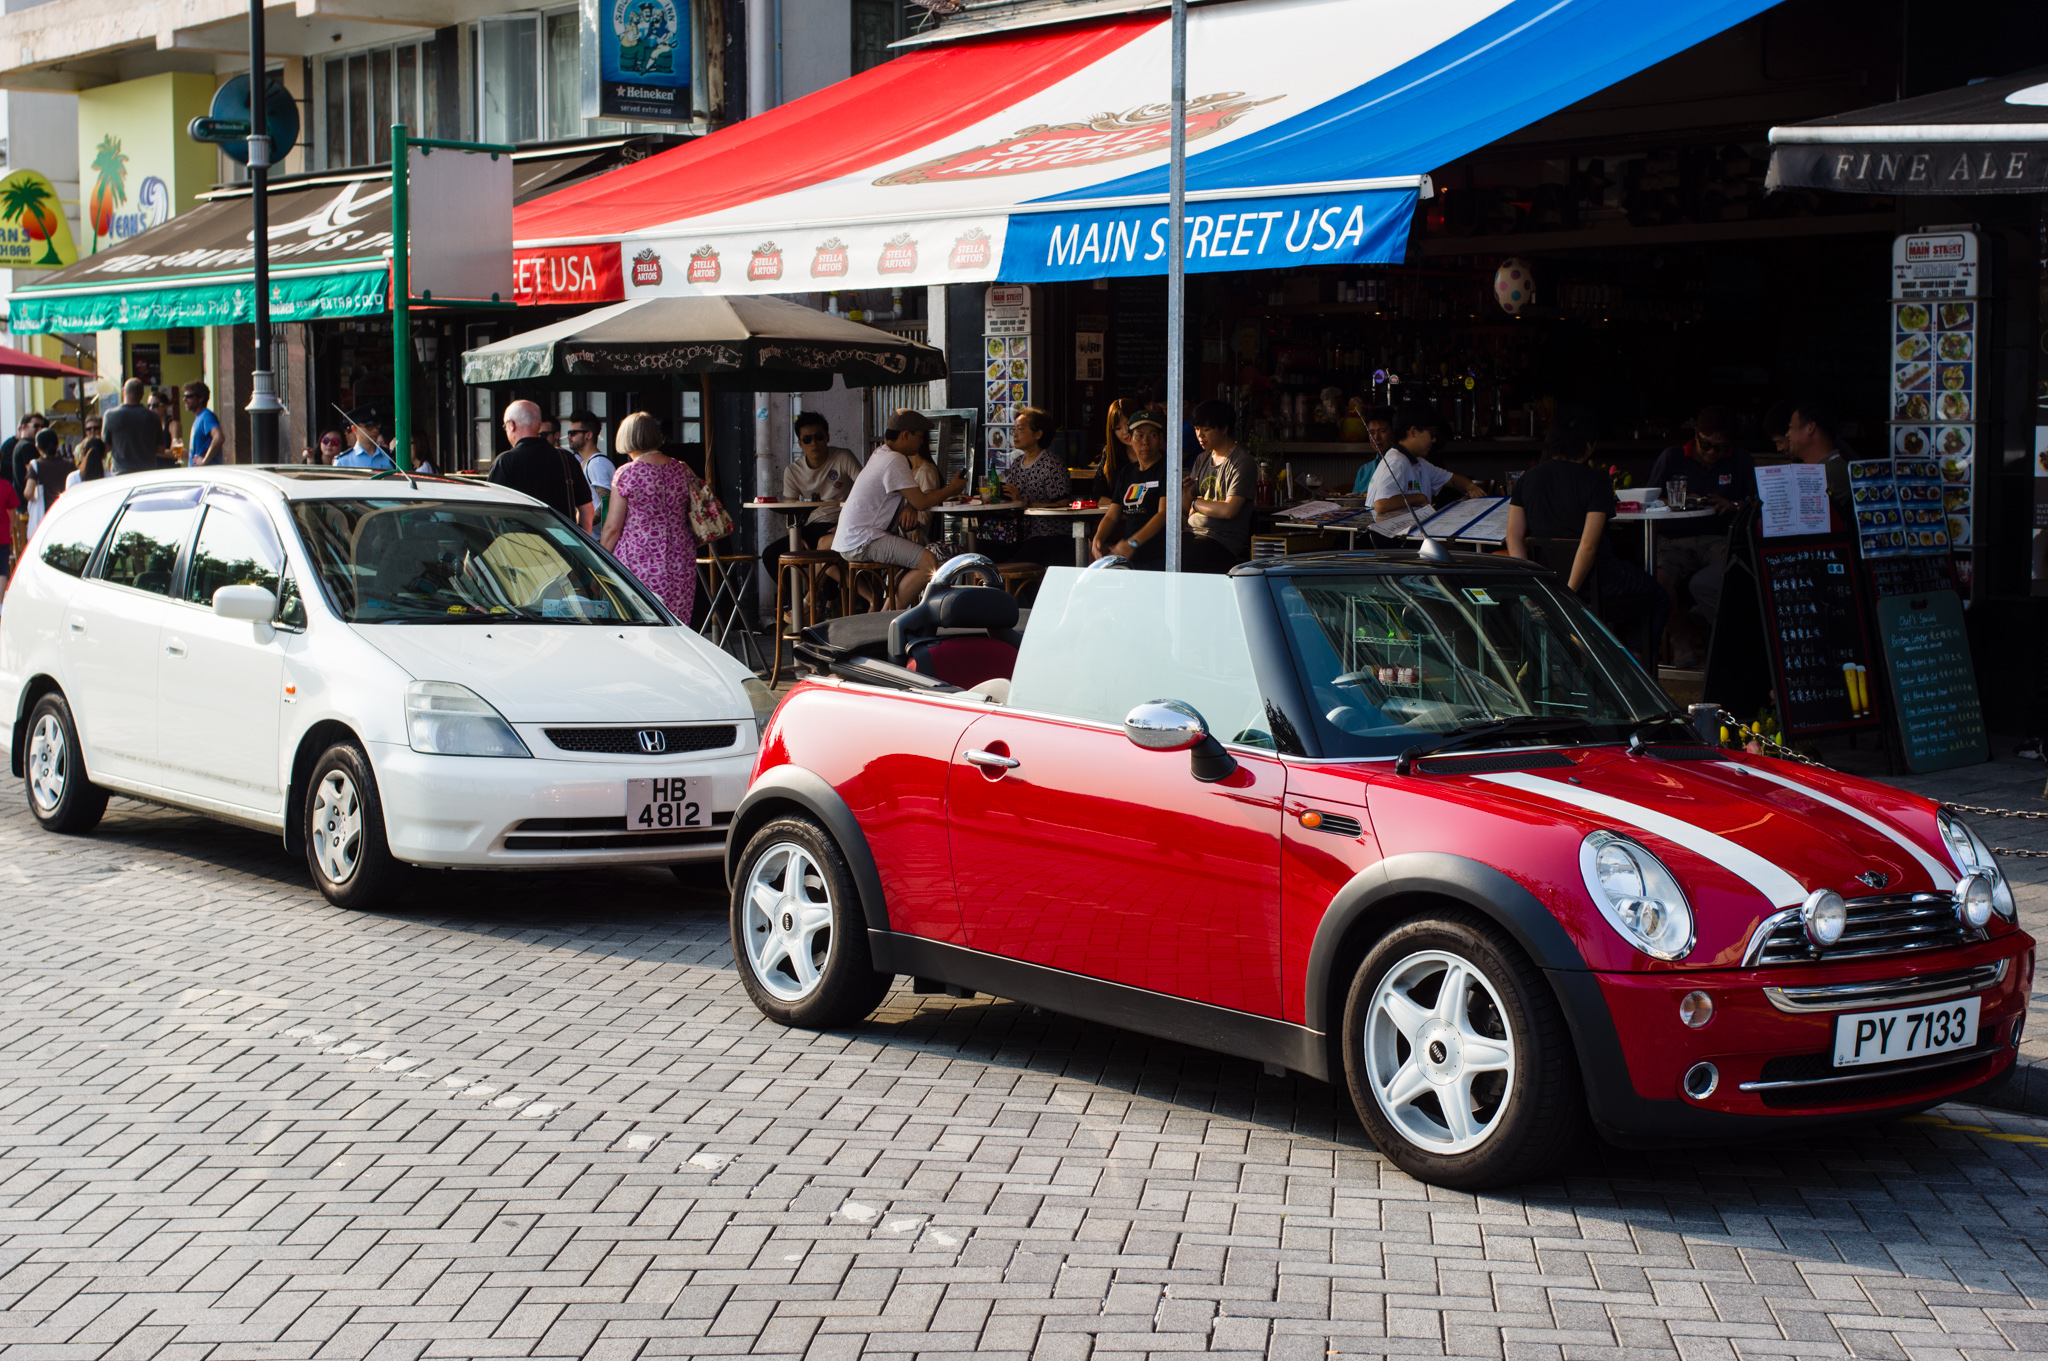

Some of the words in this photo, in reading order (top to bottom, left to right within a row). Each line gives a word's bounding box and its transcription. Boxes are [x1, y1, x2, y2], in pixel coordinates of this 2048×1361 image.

[626, 87, 675, 101] Heineken
[620, 105, 640, 113] served
[937, 143, 1146, 174] ARTOIS
[1833, 153, 1930, 181] FINE
[1948, 152, 2029, 180] ALE
[1046, 219, 1141, 267] MAIN
[1285, 205, 1364, 253] USA
[885, 249, 912, 259] STELLA
[956, 244, 985, 255] STELLA
[1908, 246, 1930, 256] MAIN
[1932, 244, 1962, 255] STREET
[754, 257, 778, 267] STELLA
[818, 253, 843, 263] STELLA
[884, 258, 911, 269] ARTOIS
[954, 252, 984, 264] ARTOIS
[636, 263, 658, 273] STELLA
[693, 260, 716, 270] STELLA
[753, 265, 777, 276] ARTOIS
[817, 262, 843, 272] ARTOIS
[551, 255, 597, 292] USA
[637, 272, 658, 282] ARTOIS
[692, 268, 716, 279] ARTOIS
[208, 300, 230, 315] Pub
[653, 777, 686, 803] HB
[638, 802, 701, 828] 4812
[1854, 1016, 1898, 1058] PY
[1906, 1006, 1967, 1052] 7133
